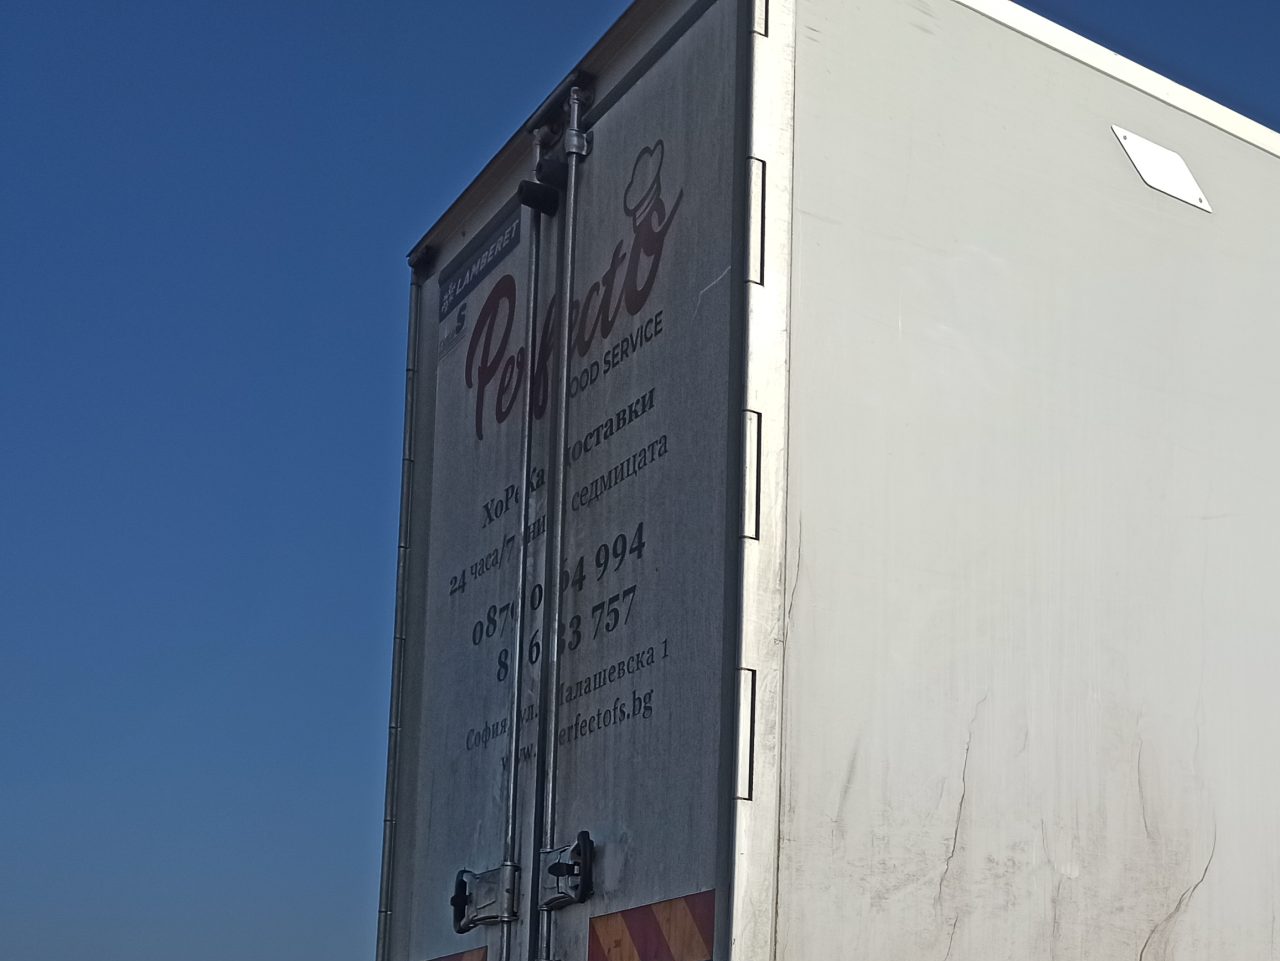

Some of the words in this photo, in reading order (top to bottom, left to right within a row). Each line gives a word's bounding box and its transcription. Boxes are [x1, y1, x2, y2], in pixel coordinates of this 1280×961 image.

[454, 219, 520, 296] LAMBERET
[568, 364, 600, 399] OOD
[602, 310, 664, 375] SERVICE
[566, 387, 656, 464] оставки
[449, 570, 467, 596] 24
[571, 434, 668, 511] седмицата
[595, 521, 646, 583] 994
[591, 584, 637, 641] 757
[557, 647, 656, 707] алашевска
[661, 638, 670, 660] 1
